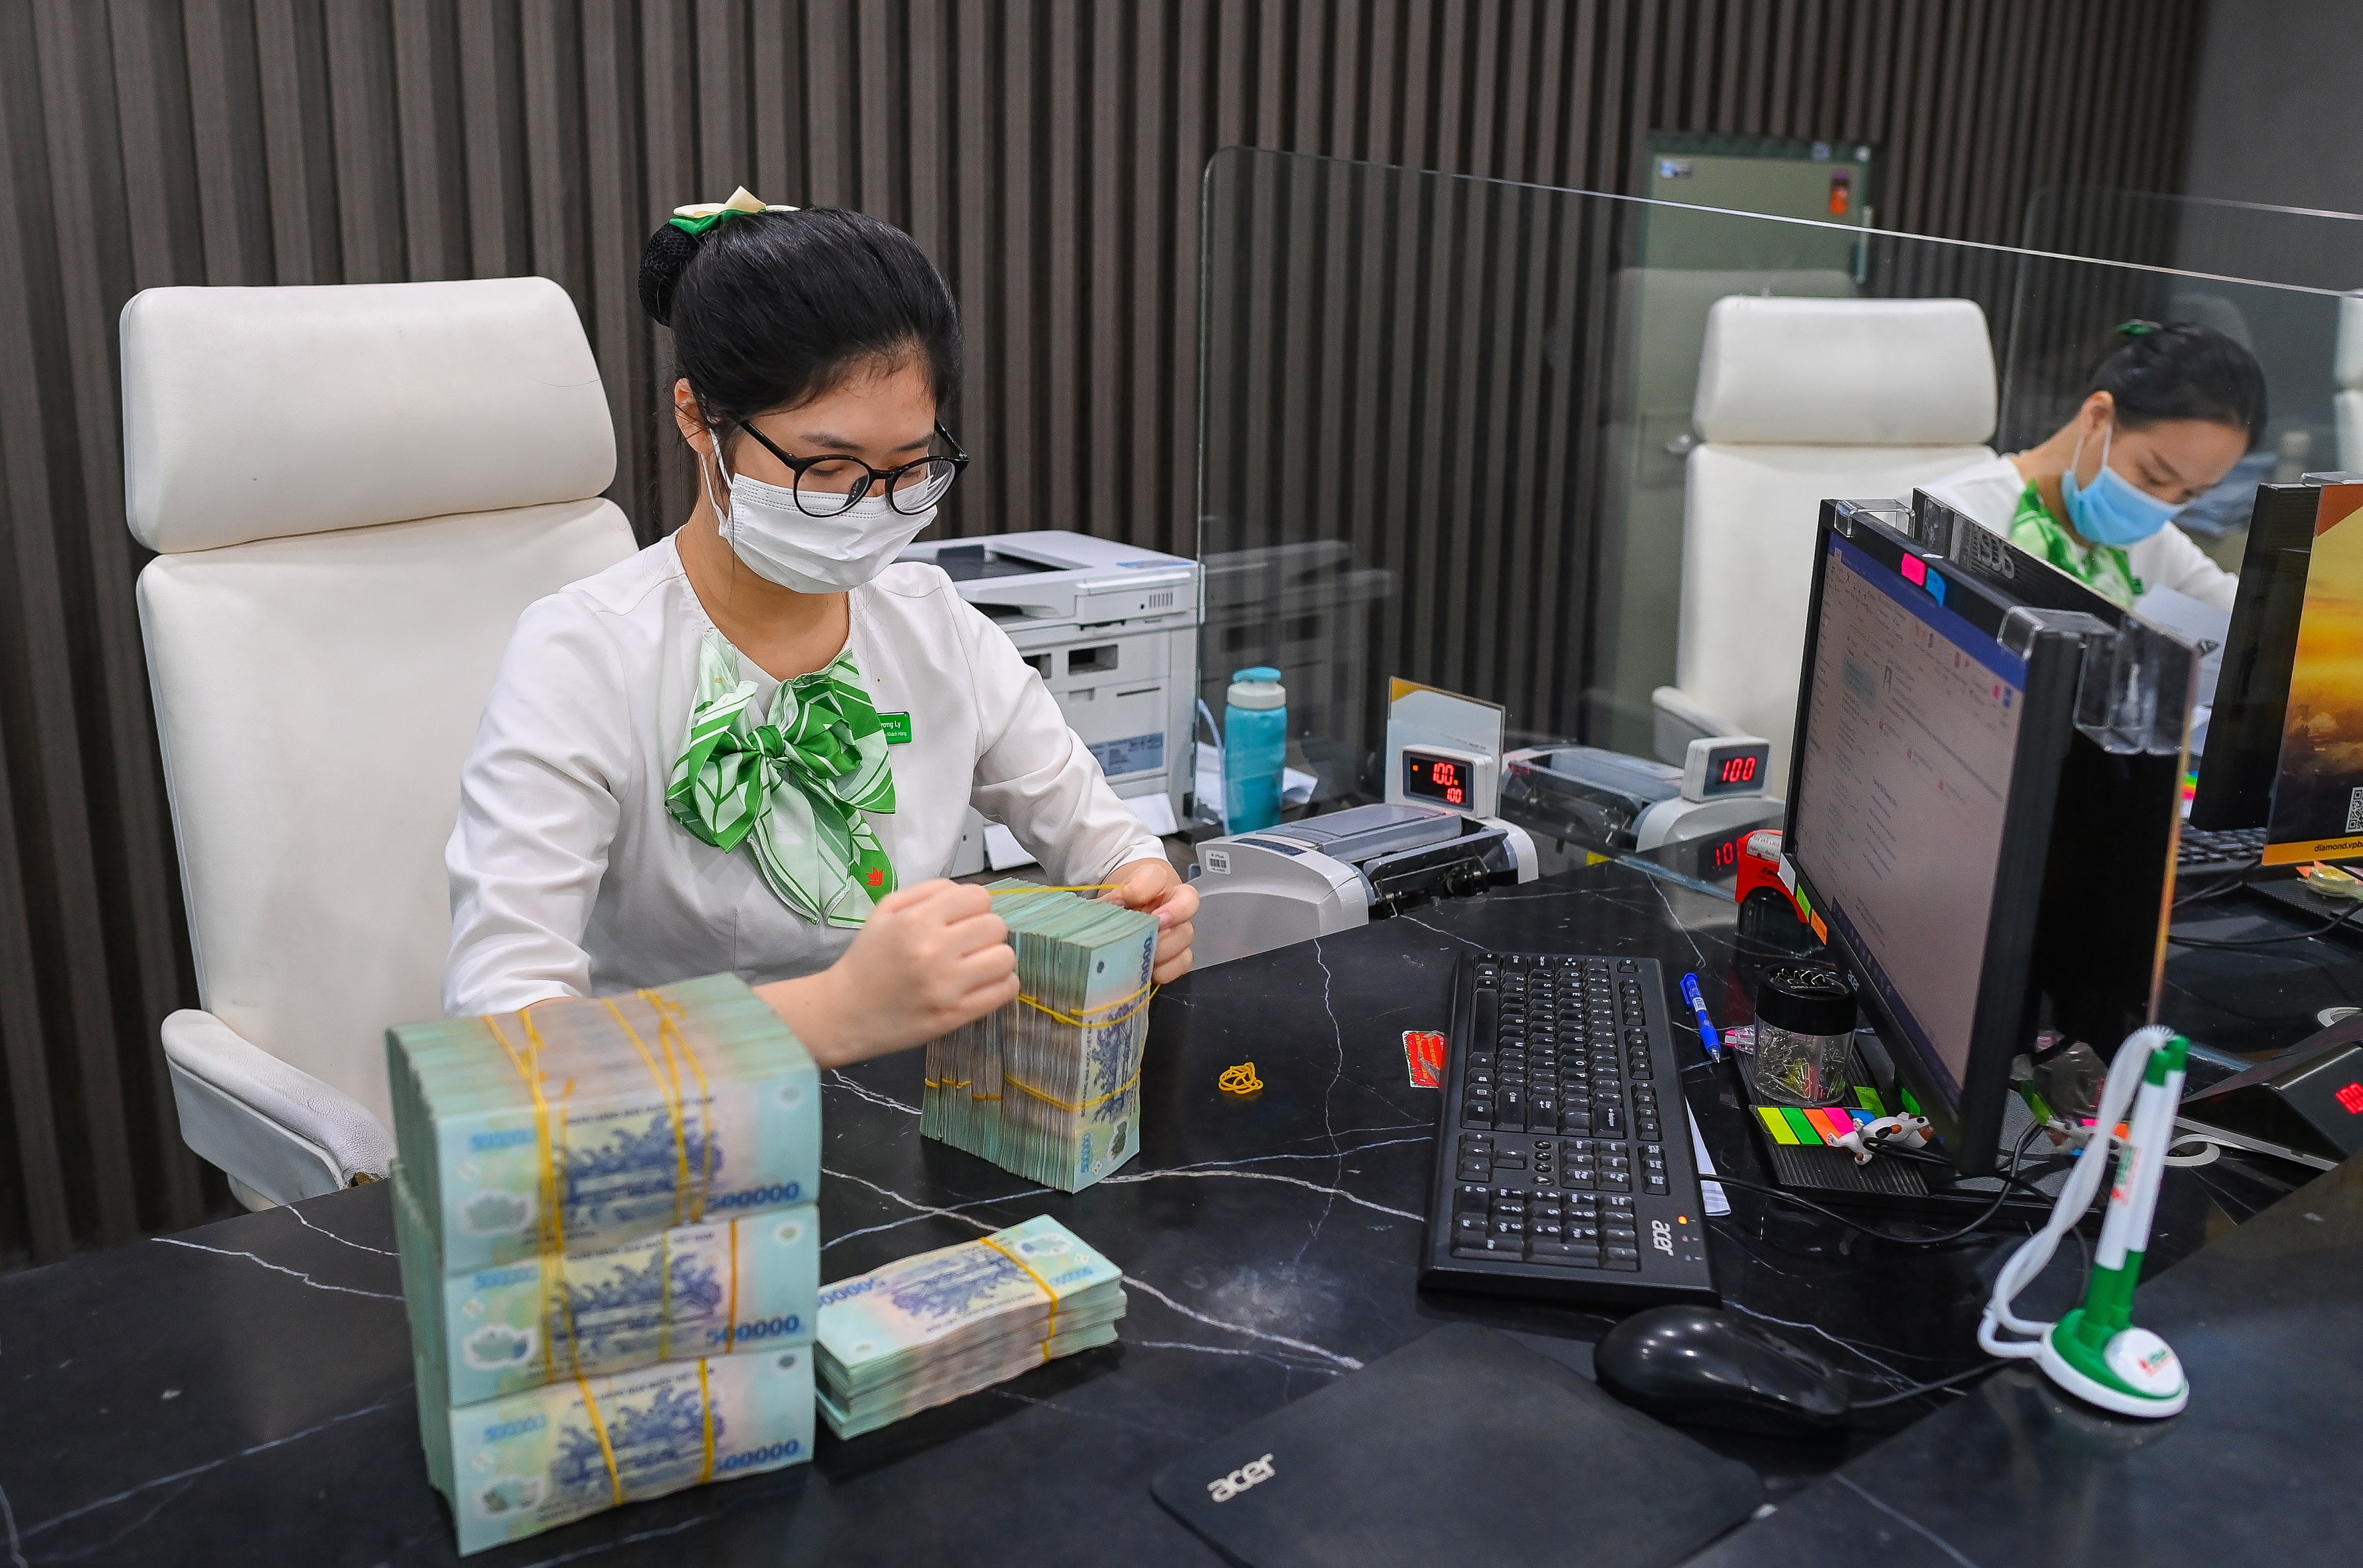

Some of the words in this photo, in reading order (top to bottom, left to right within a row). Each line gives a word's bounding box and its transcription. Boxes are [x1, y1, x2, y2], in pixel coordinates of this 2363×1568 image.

[894, 720, 901, 729] Ly
[1433, 762, 1454, 785] 100
[1723, 756, 1756, 783] 100
[1447, 788, 1462, 803] 100
[1651, 1220, 1674, 1256] acer
[1207, 1453, 1275, 1502] acer
